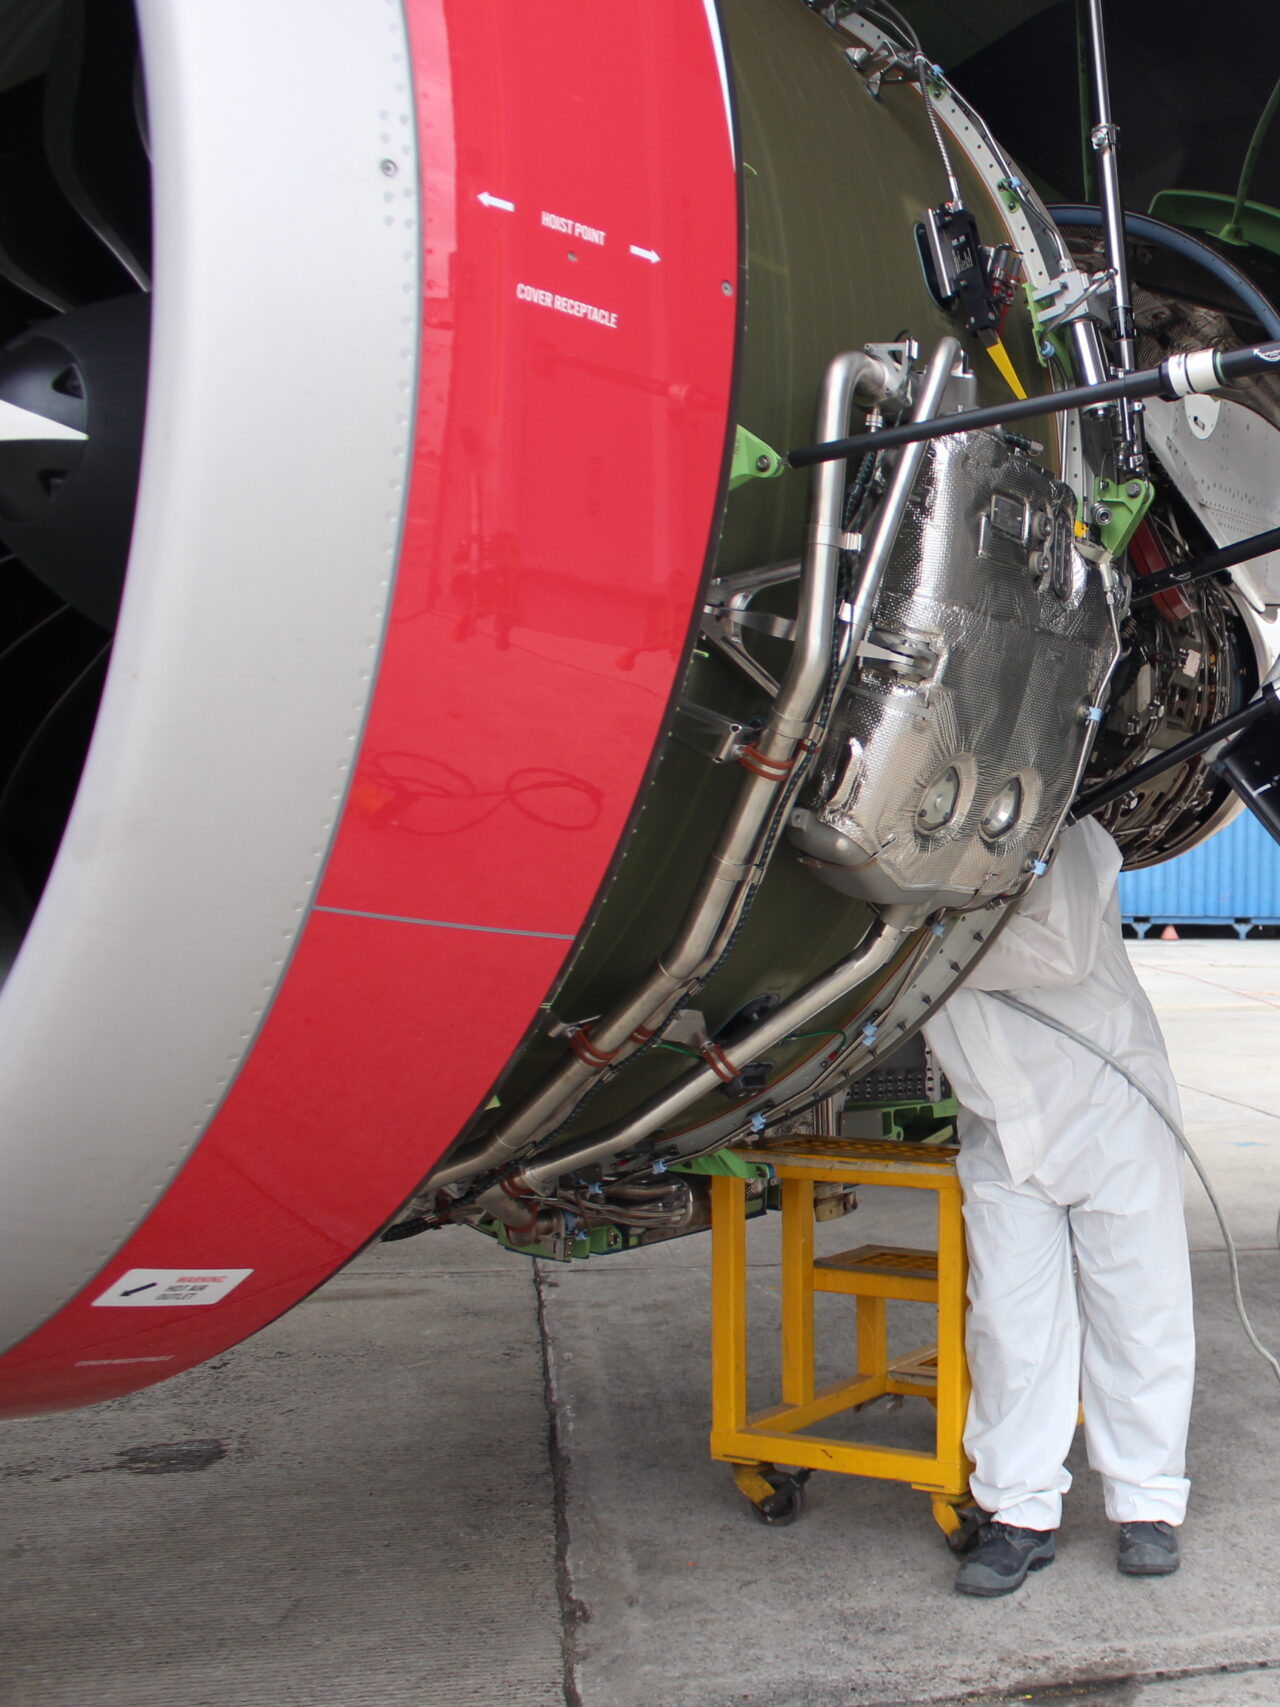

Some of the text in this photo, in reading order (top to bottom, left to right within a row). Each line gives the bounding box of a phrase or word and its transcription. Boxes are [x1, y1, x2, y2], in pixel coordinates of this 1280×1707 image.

[541, 210, 606, 246] HOIST POINT
[516, 282, 618, 328] COVER RECEPTACLE
[176, 1275, 228, 1283] WARNING
[155, 1292, 199, 1300] OUTLET
